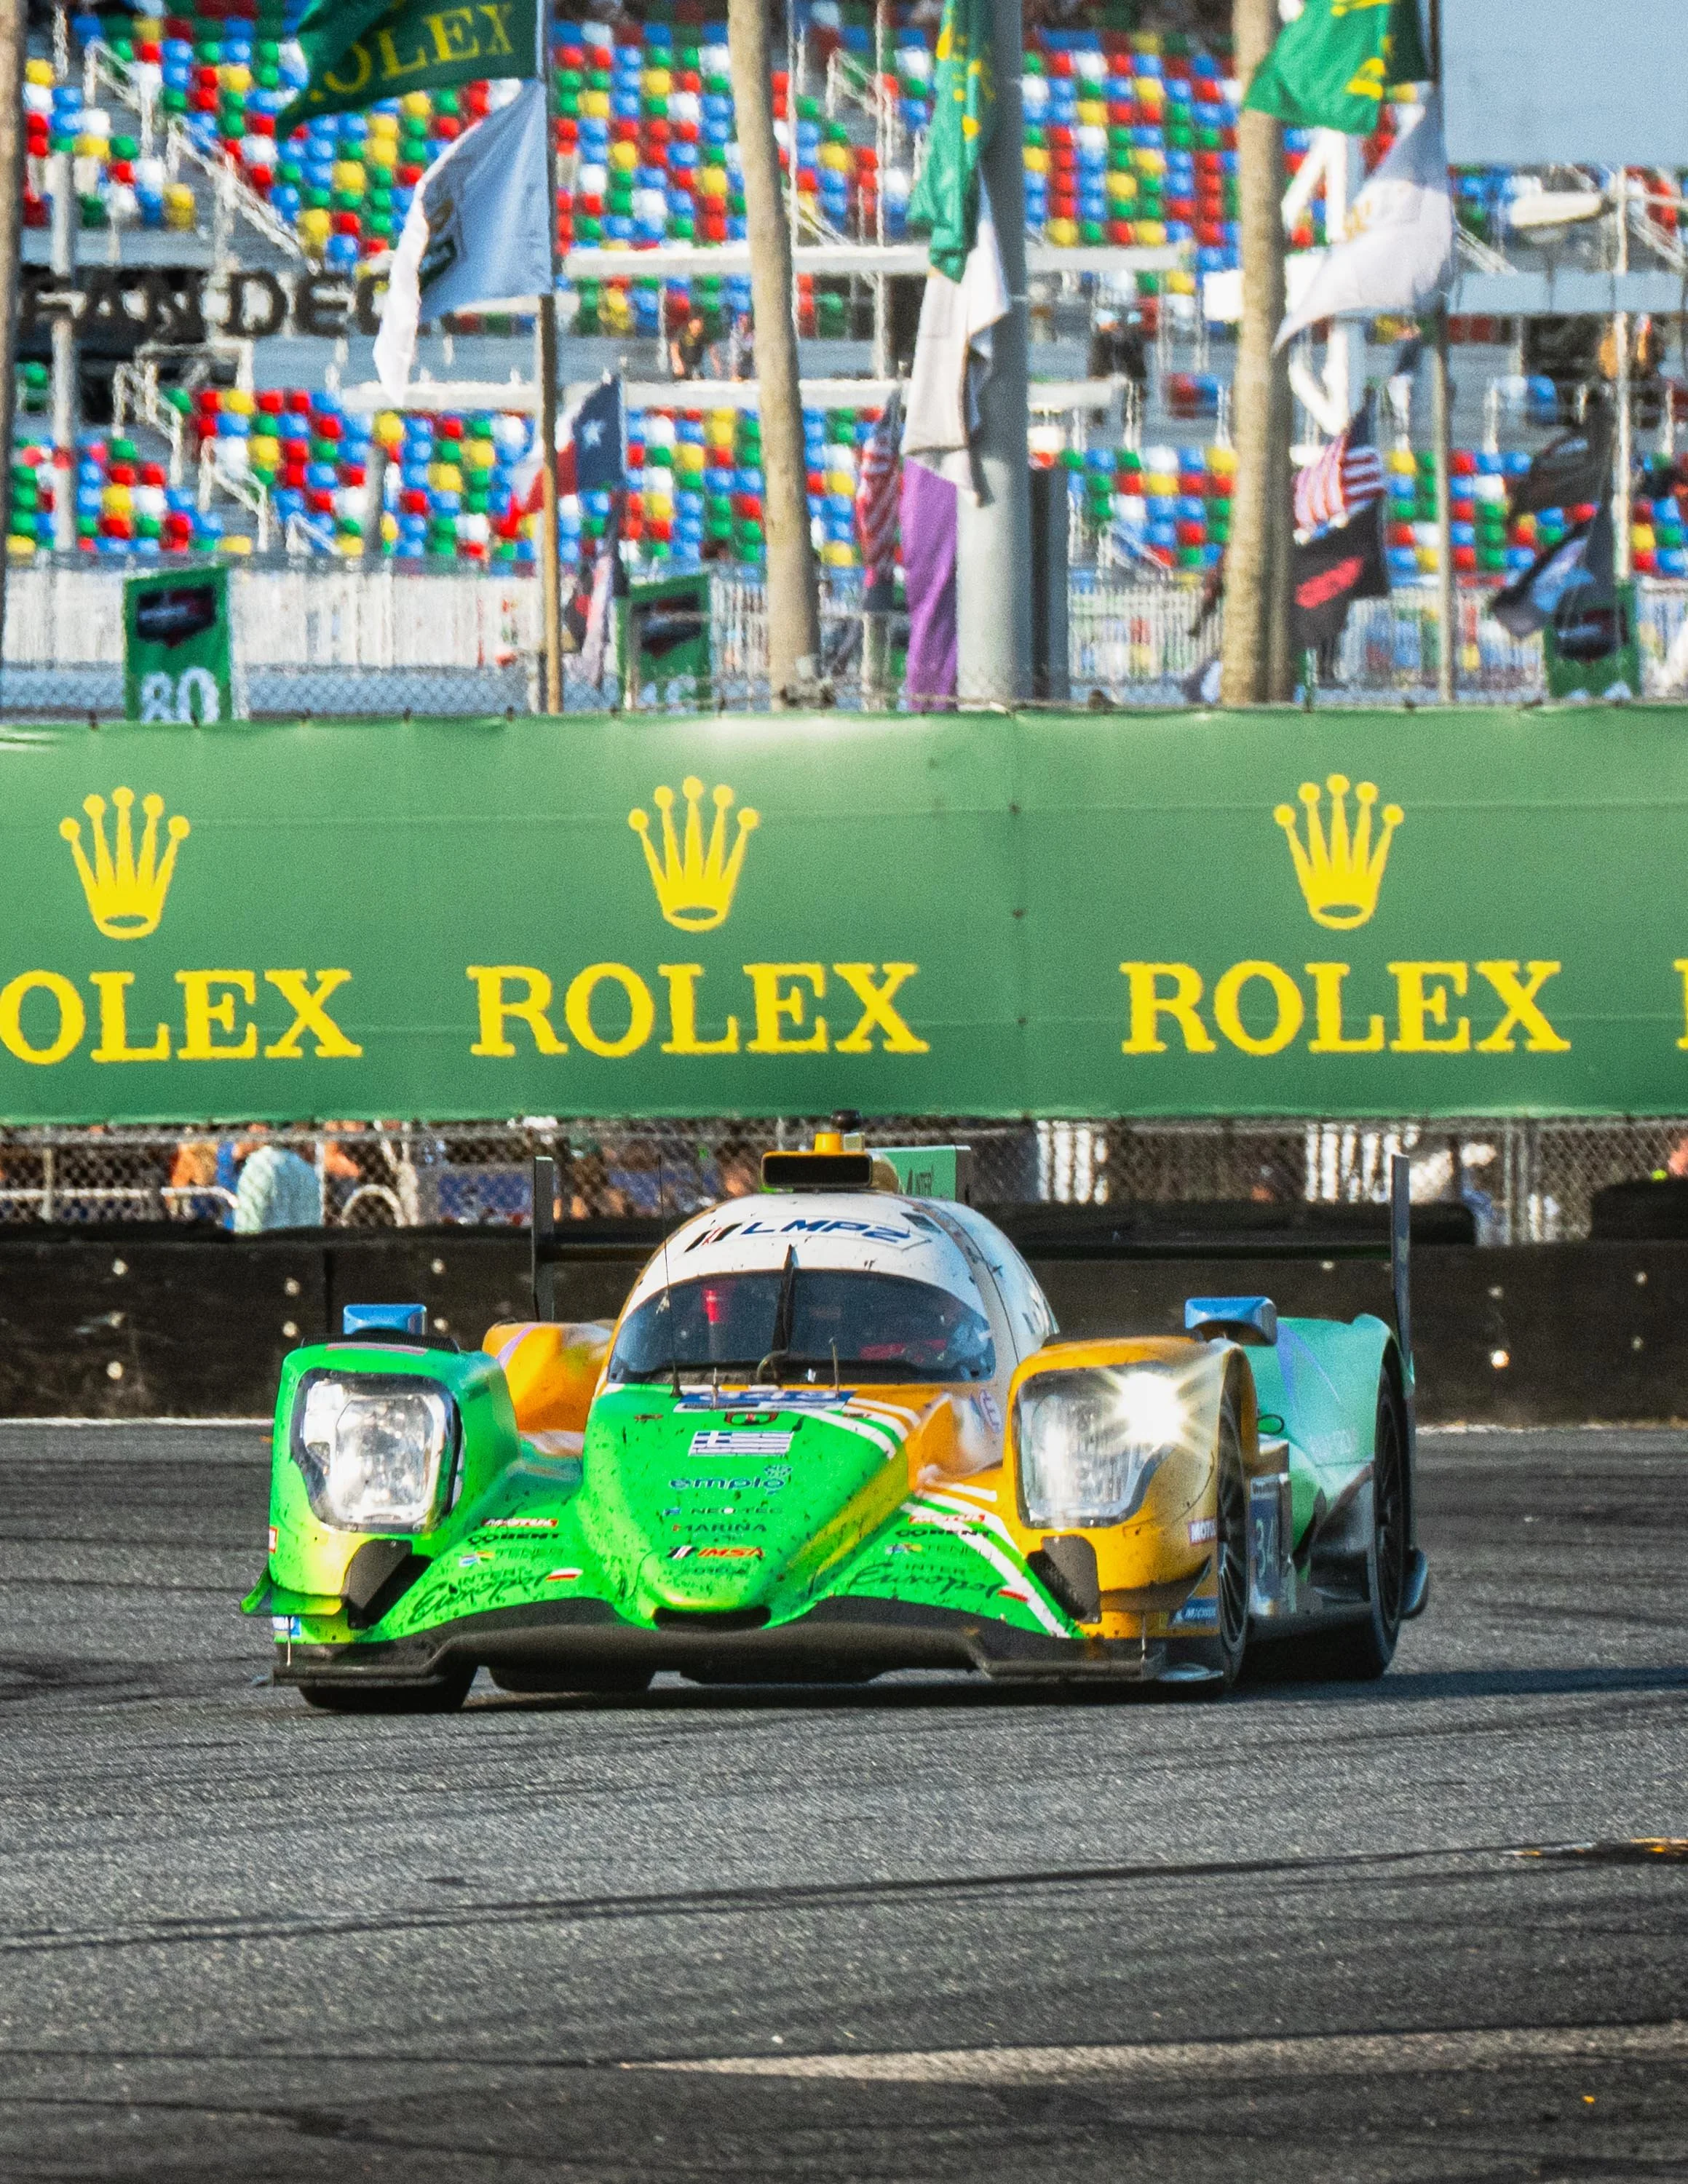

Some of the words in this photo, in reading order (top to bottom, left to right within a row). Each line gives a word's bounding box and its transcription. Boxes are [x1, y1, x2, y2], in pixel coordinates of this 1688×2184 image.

[310, 4, 514, 103] OLEX
[140, 667, 219, 723] 80
[0, 969, 362, 1065] OLEX
[466, 962, 930, 1058] ROLEX
[1119, 960, 1572, 1055] ROLEX
[740, 1218, 912, 1243] LMP2
[697, 1547, 764, 1560] IMSA
